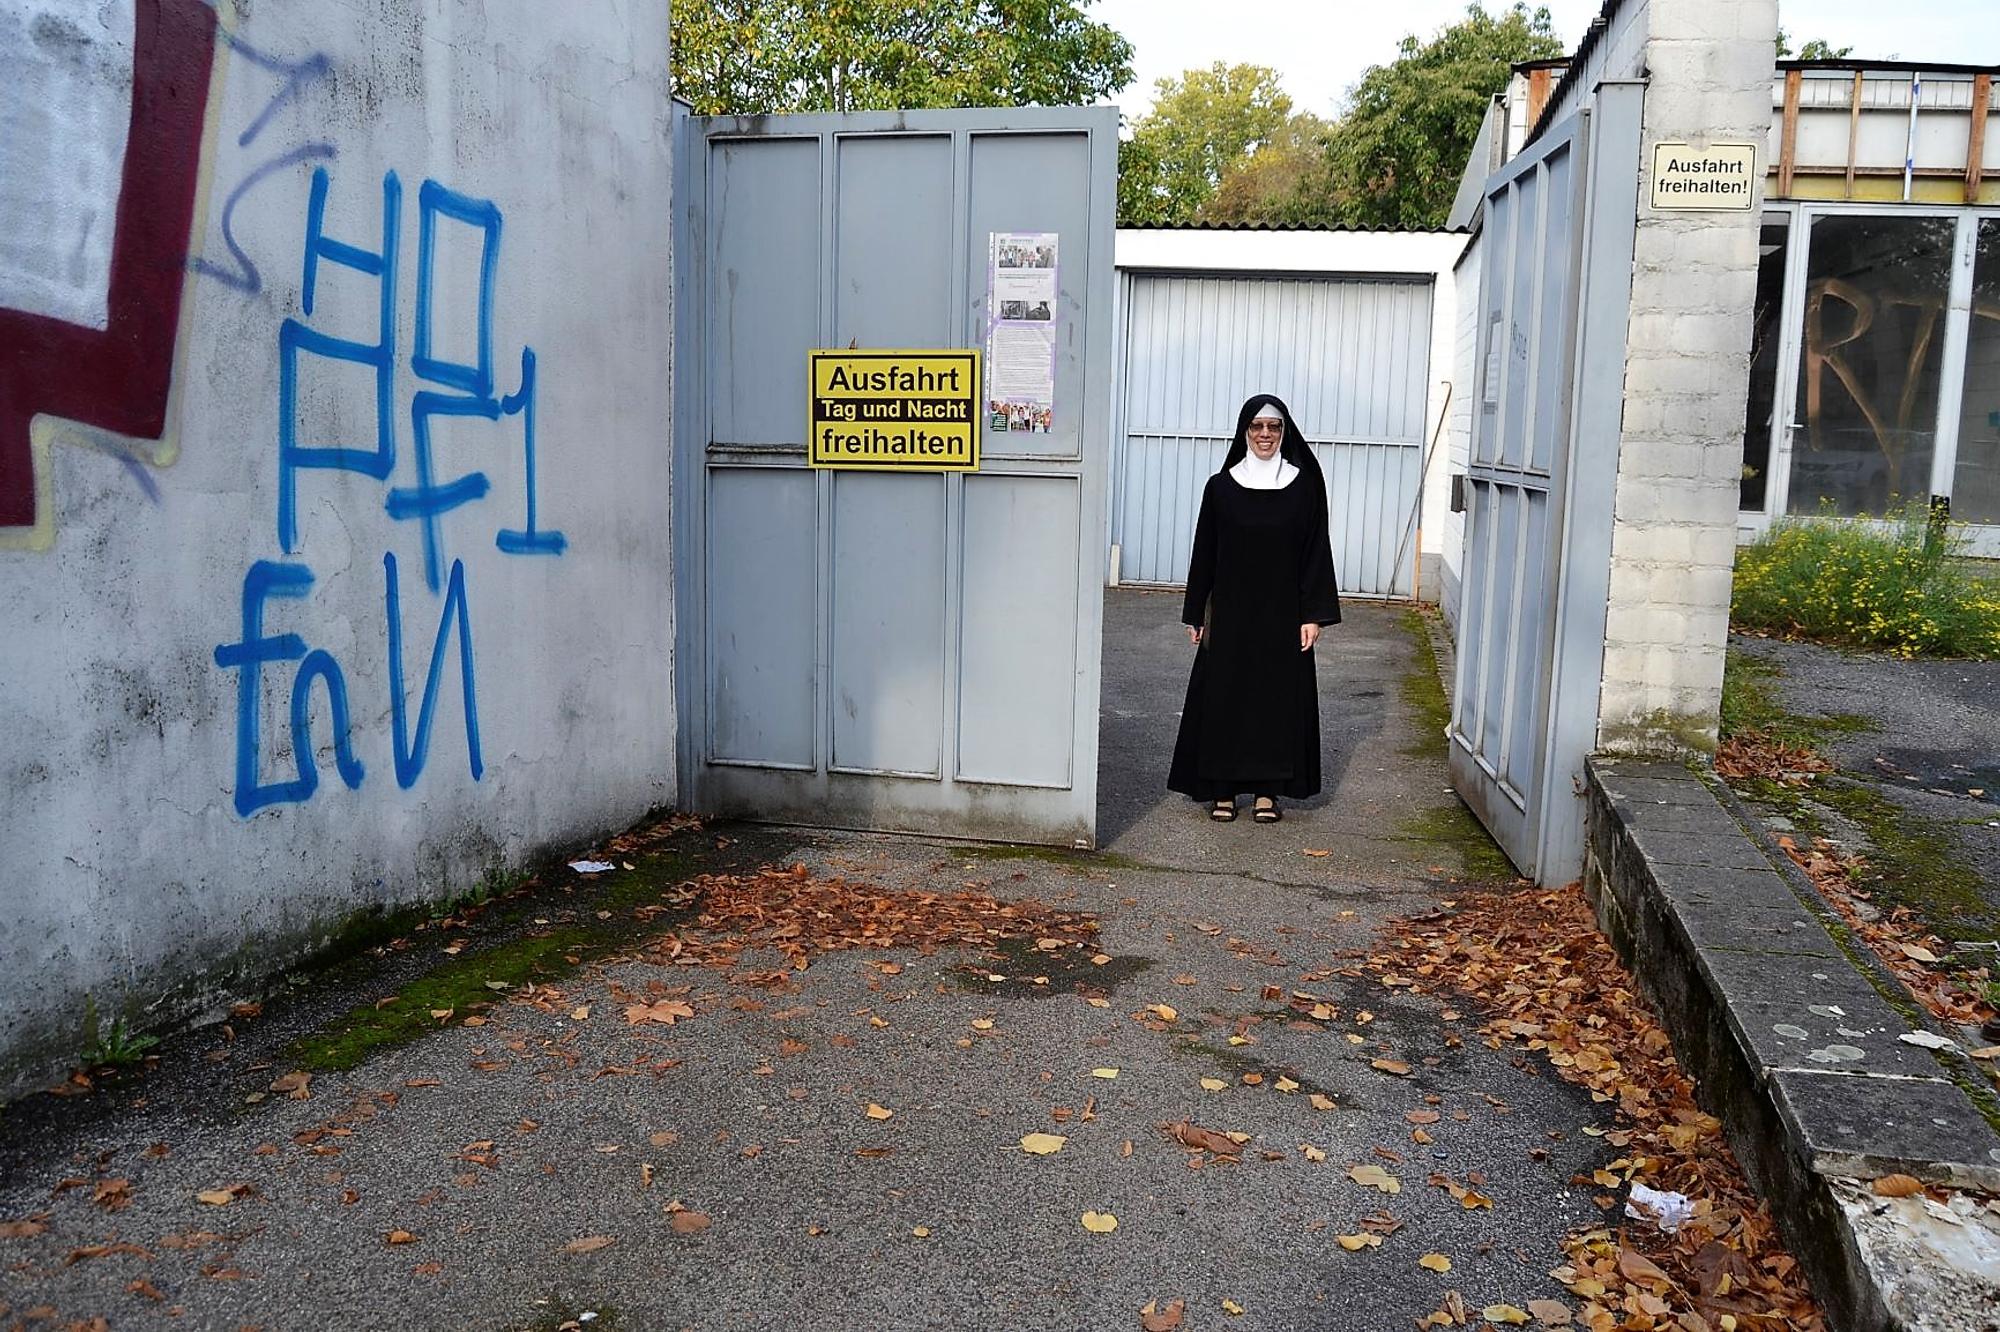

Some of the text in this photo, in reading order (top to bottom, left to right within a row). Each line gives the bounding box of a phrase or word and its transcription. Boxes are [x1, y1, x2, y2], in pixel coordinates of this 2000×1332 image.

[1667, 158, 1744, 174] Ausfahrt
[1659, 178, 1748, 194] freihalten!
[828, 366, 960, 392] Ausfahrt
[821, 400, 967, 422] Tag und Nacht
[822, 428, 964, 455] freihalten
